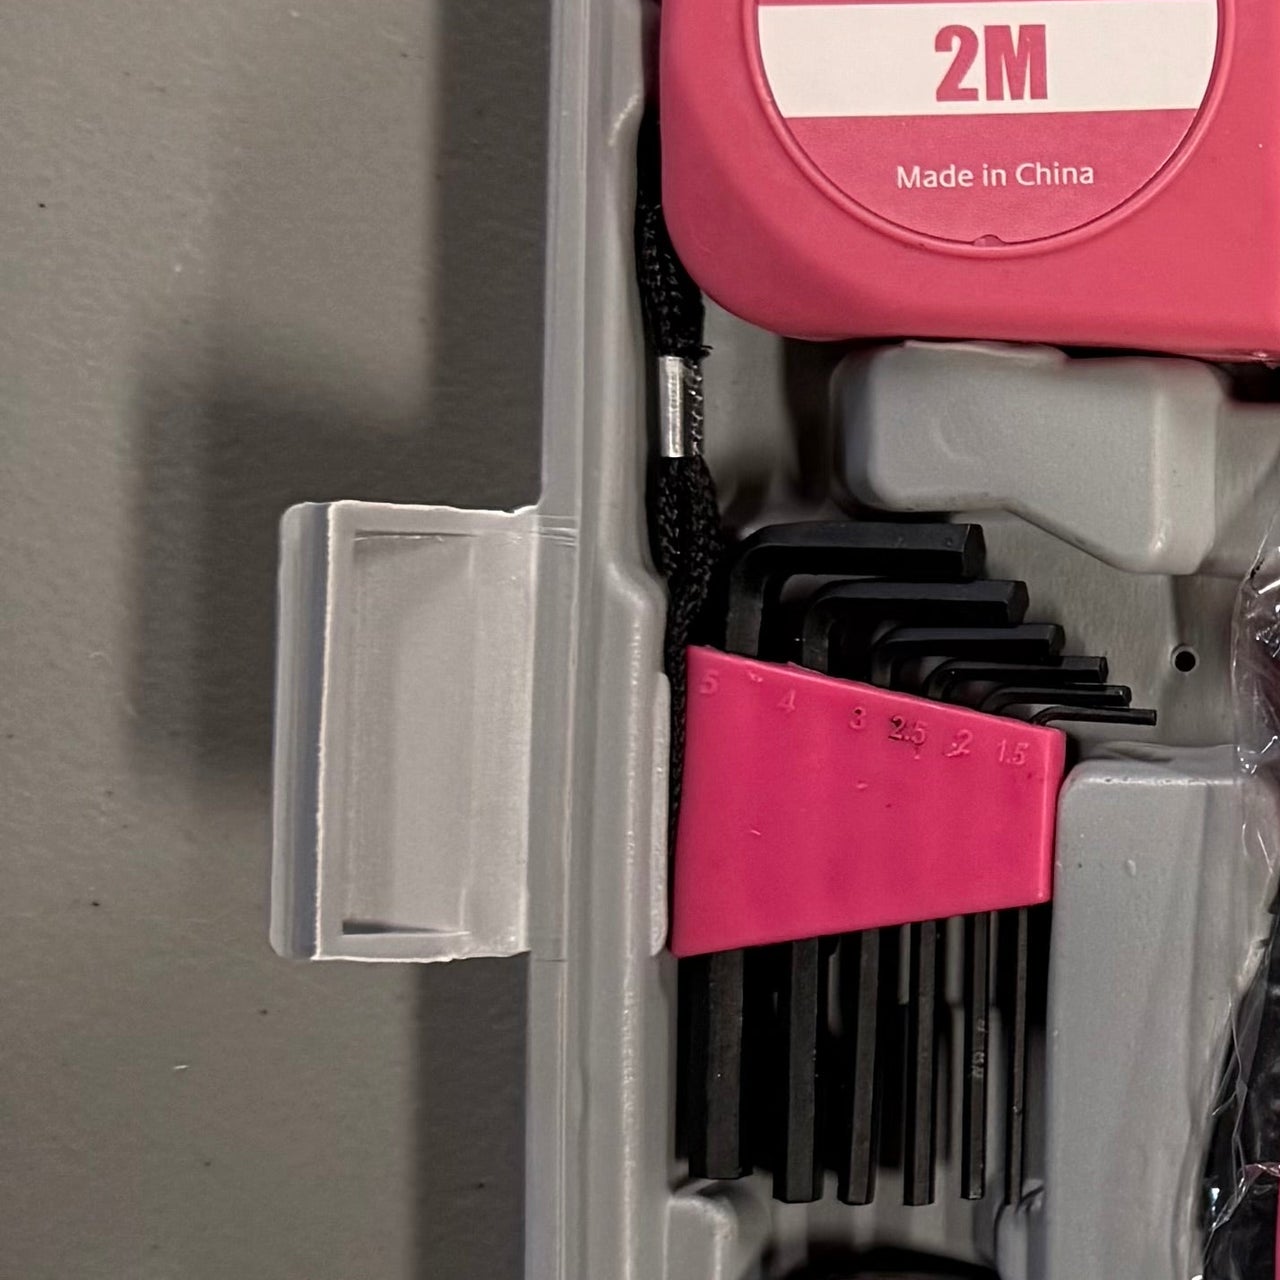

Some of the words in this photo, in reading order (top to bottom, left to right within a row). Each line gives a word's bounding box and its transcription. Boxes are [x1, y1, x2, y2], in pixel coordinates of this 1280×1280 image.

[934, 23, 1048, 103] 2M
[896, 164, 975, 190] Made
[982, 166, 1008, 187] in
[1015, 162, 1095, 187] China
[849, 706, 867, 730] 3
[888, 714, 928, 746] 2.5
[998, 738, 1030, 765] 1.5
